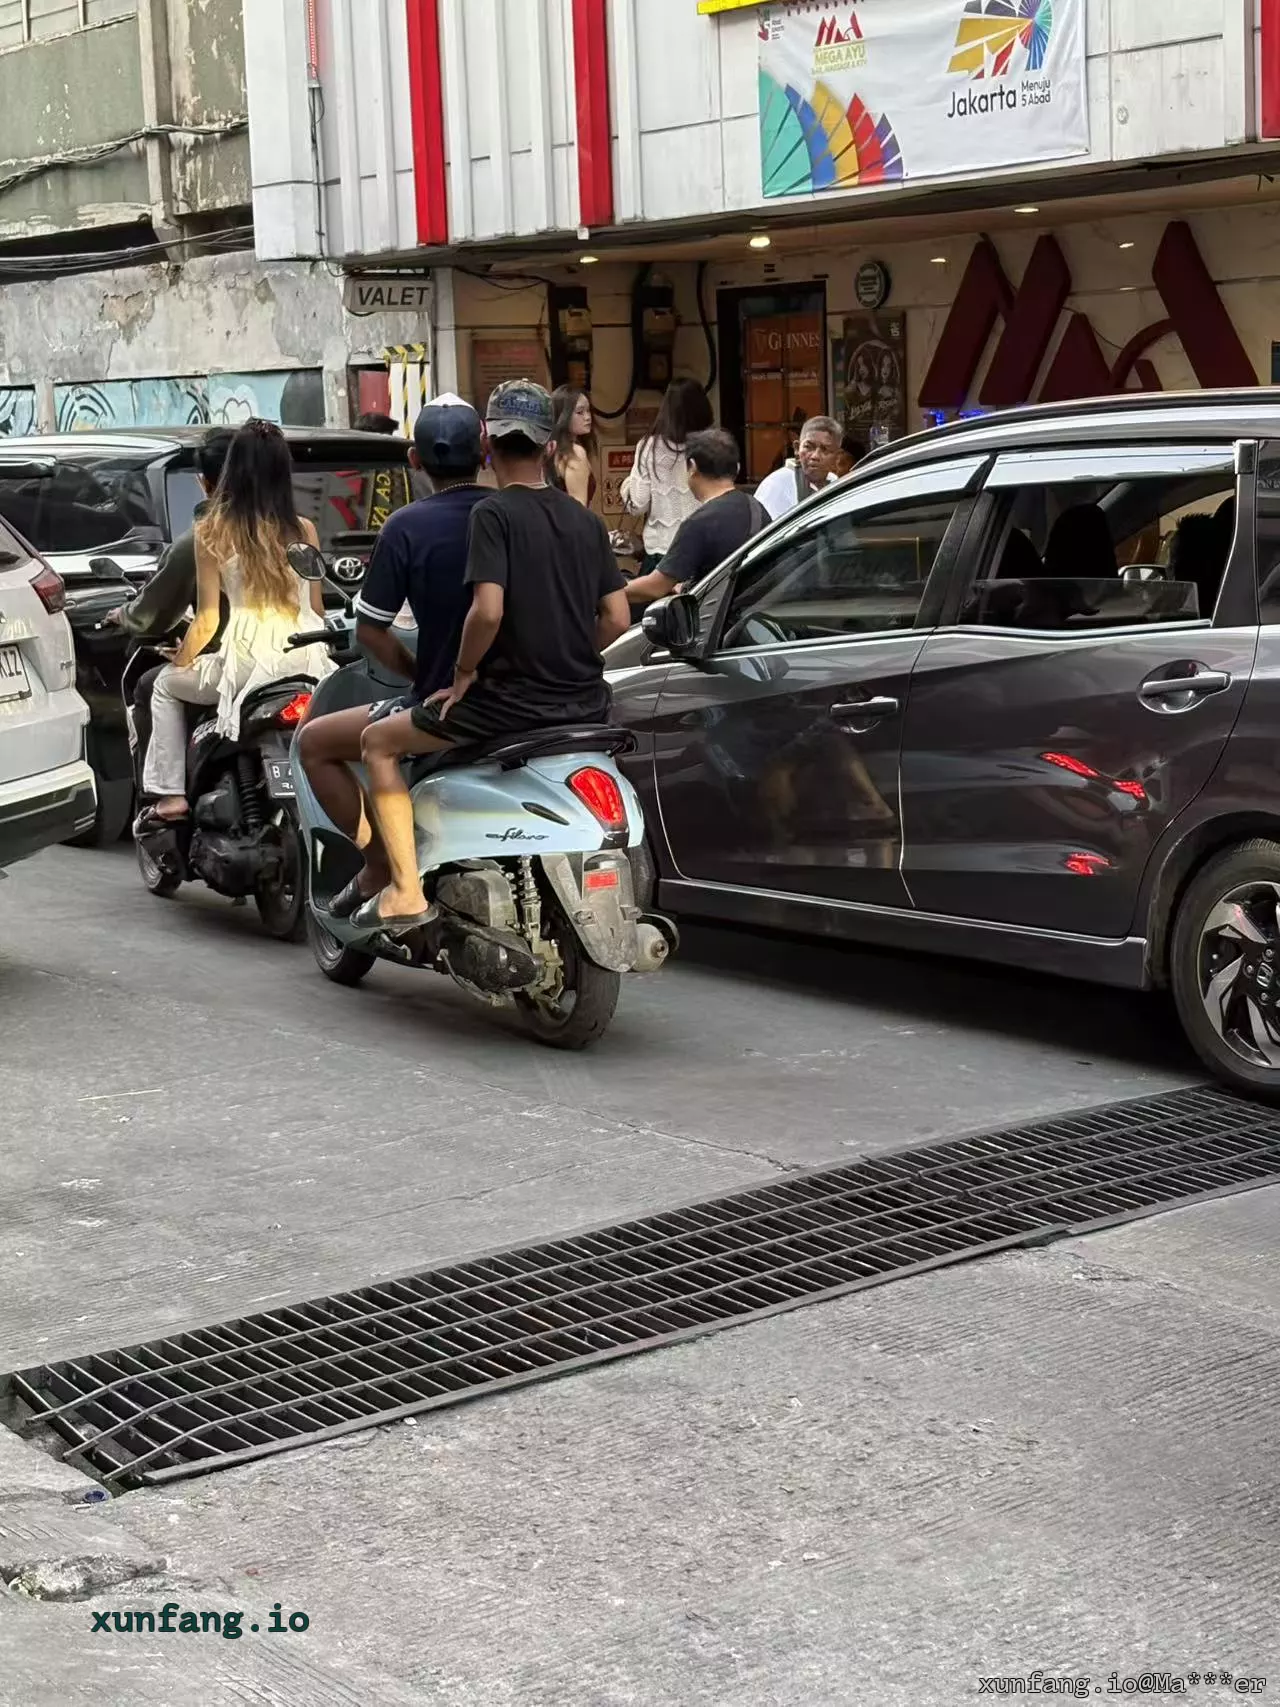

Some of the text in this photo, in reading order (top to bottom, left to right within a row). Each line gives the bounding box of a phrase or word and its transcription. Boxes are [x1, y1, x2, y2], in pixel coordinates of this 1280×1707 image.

[815, 44, 865, 64] MEGA AYU
[1021, 77, 1051, 93] Menuju
[947, 84, 1016, 118] Jakarta
[1021, 90, 1051, 107] 5 Abad
[358, 286, 430, 306] VALET
[271, 765, 281, 779] B
